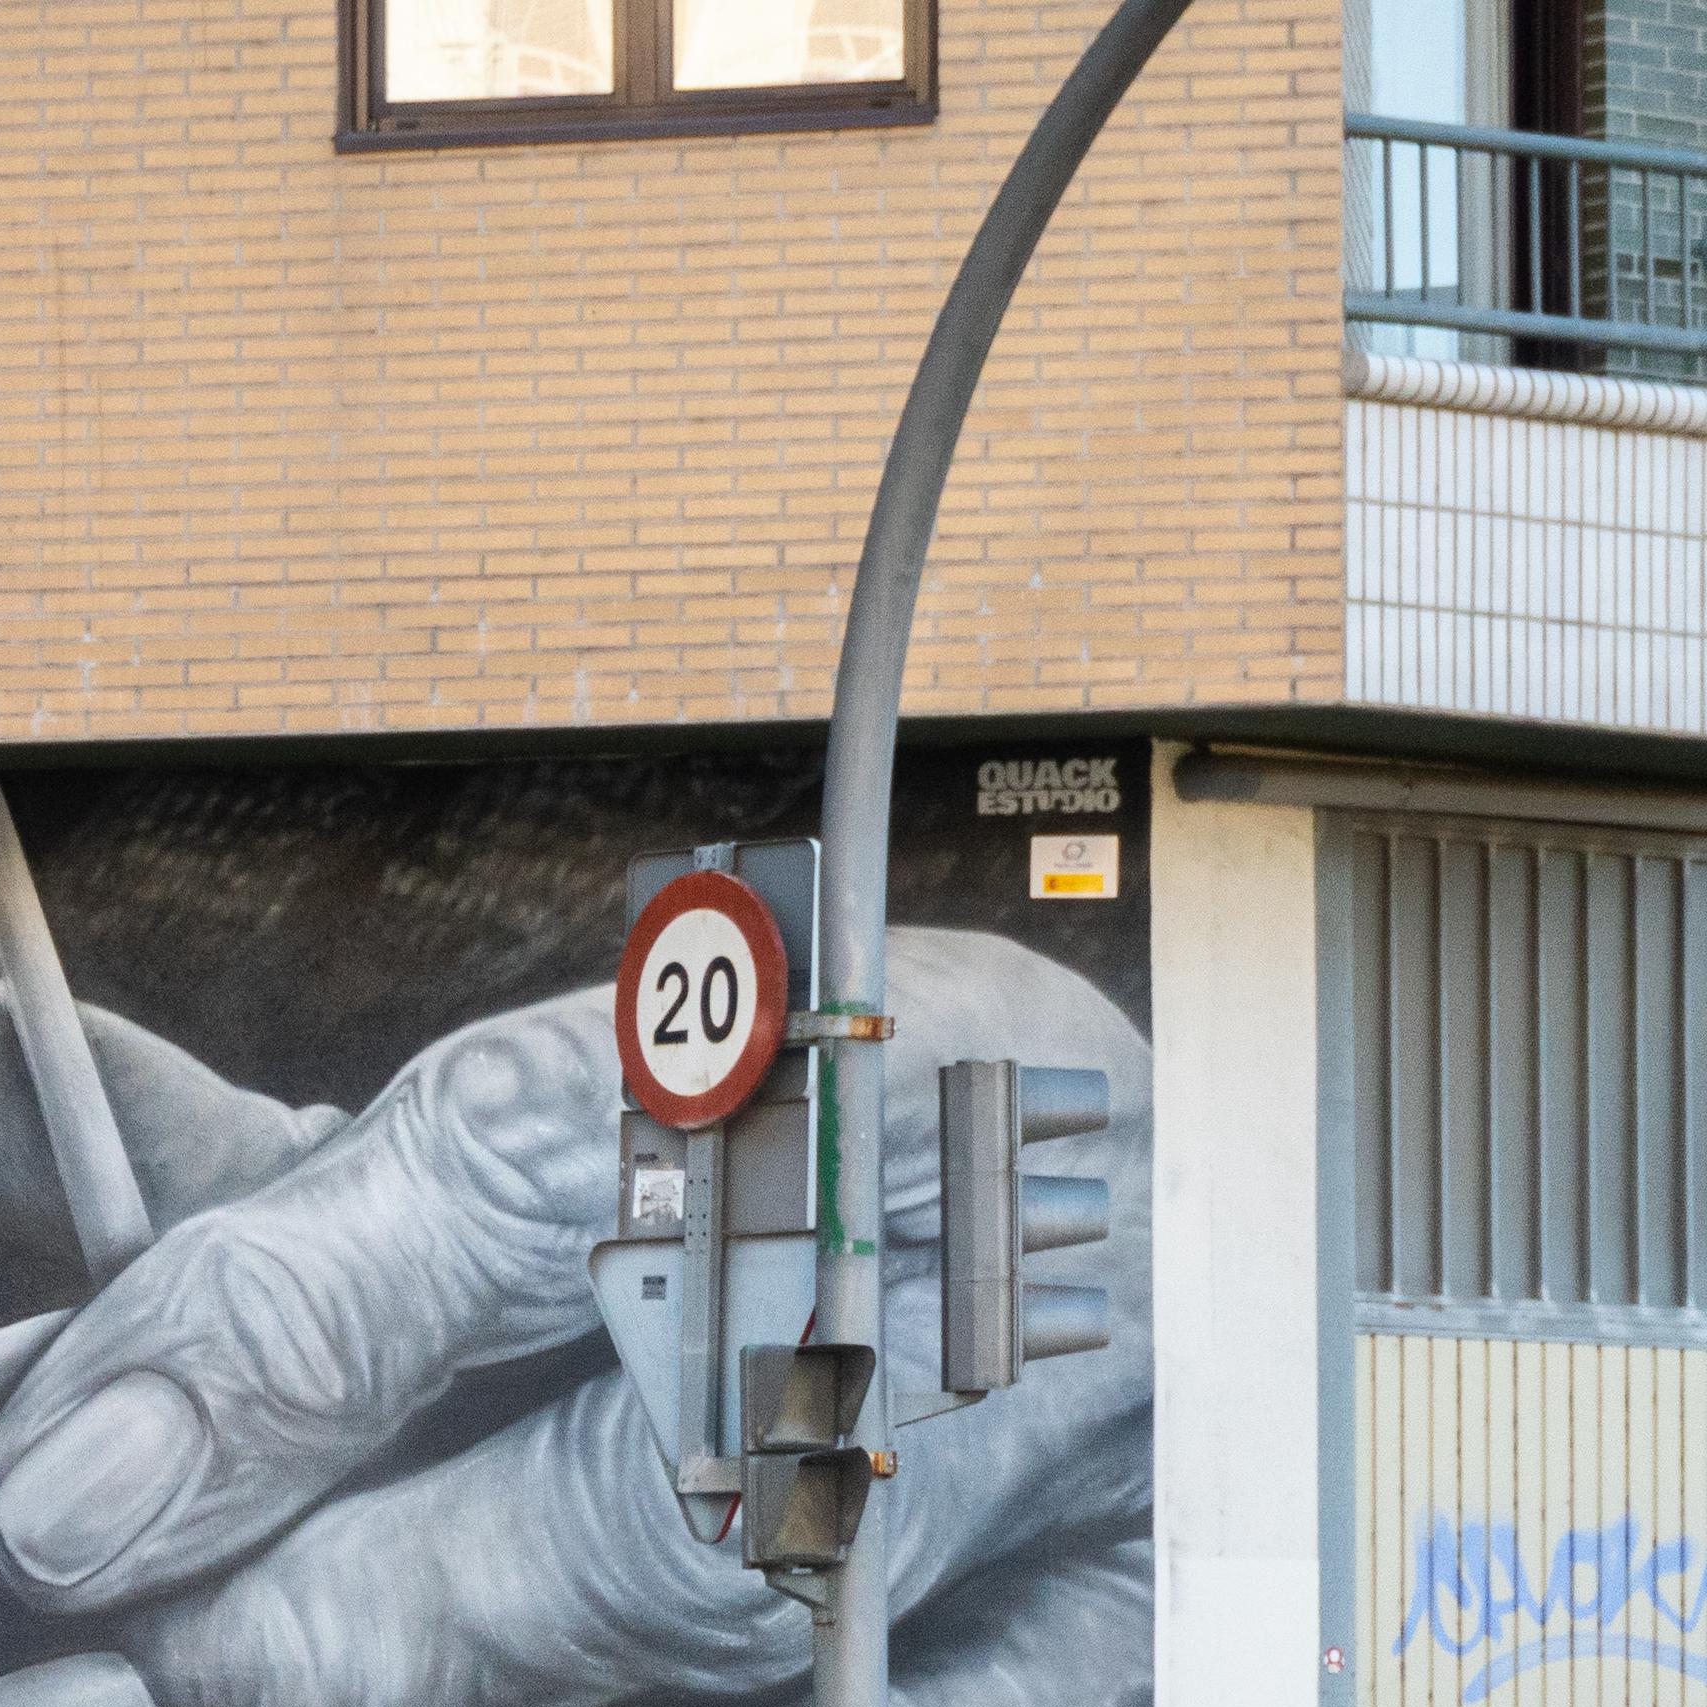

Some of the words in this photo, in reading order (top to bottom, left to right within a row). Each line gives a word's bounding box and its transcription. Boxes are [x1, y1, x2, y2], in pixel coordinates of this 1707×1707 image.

[977, 758, 1118, 790] QUACK
[976, 787, 1121, 816] ESTUDIO
[653, 956, 738, 1045] 20
